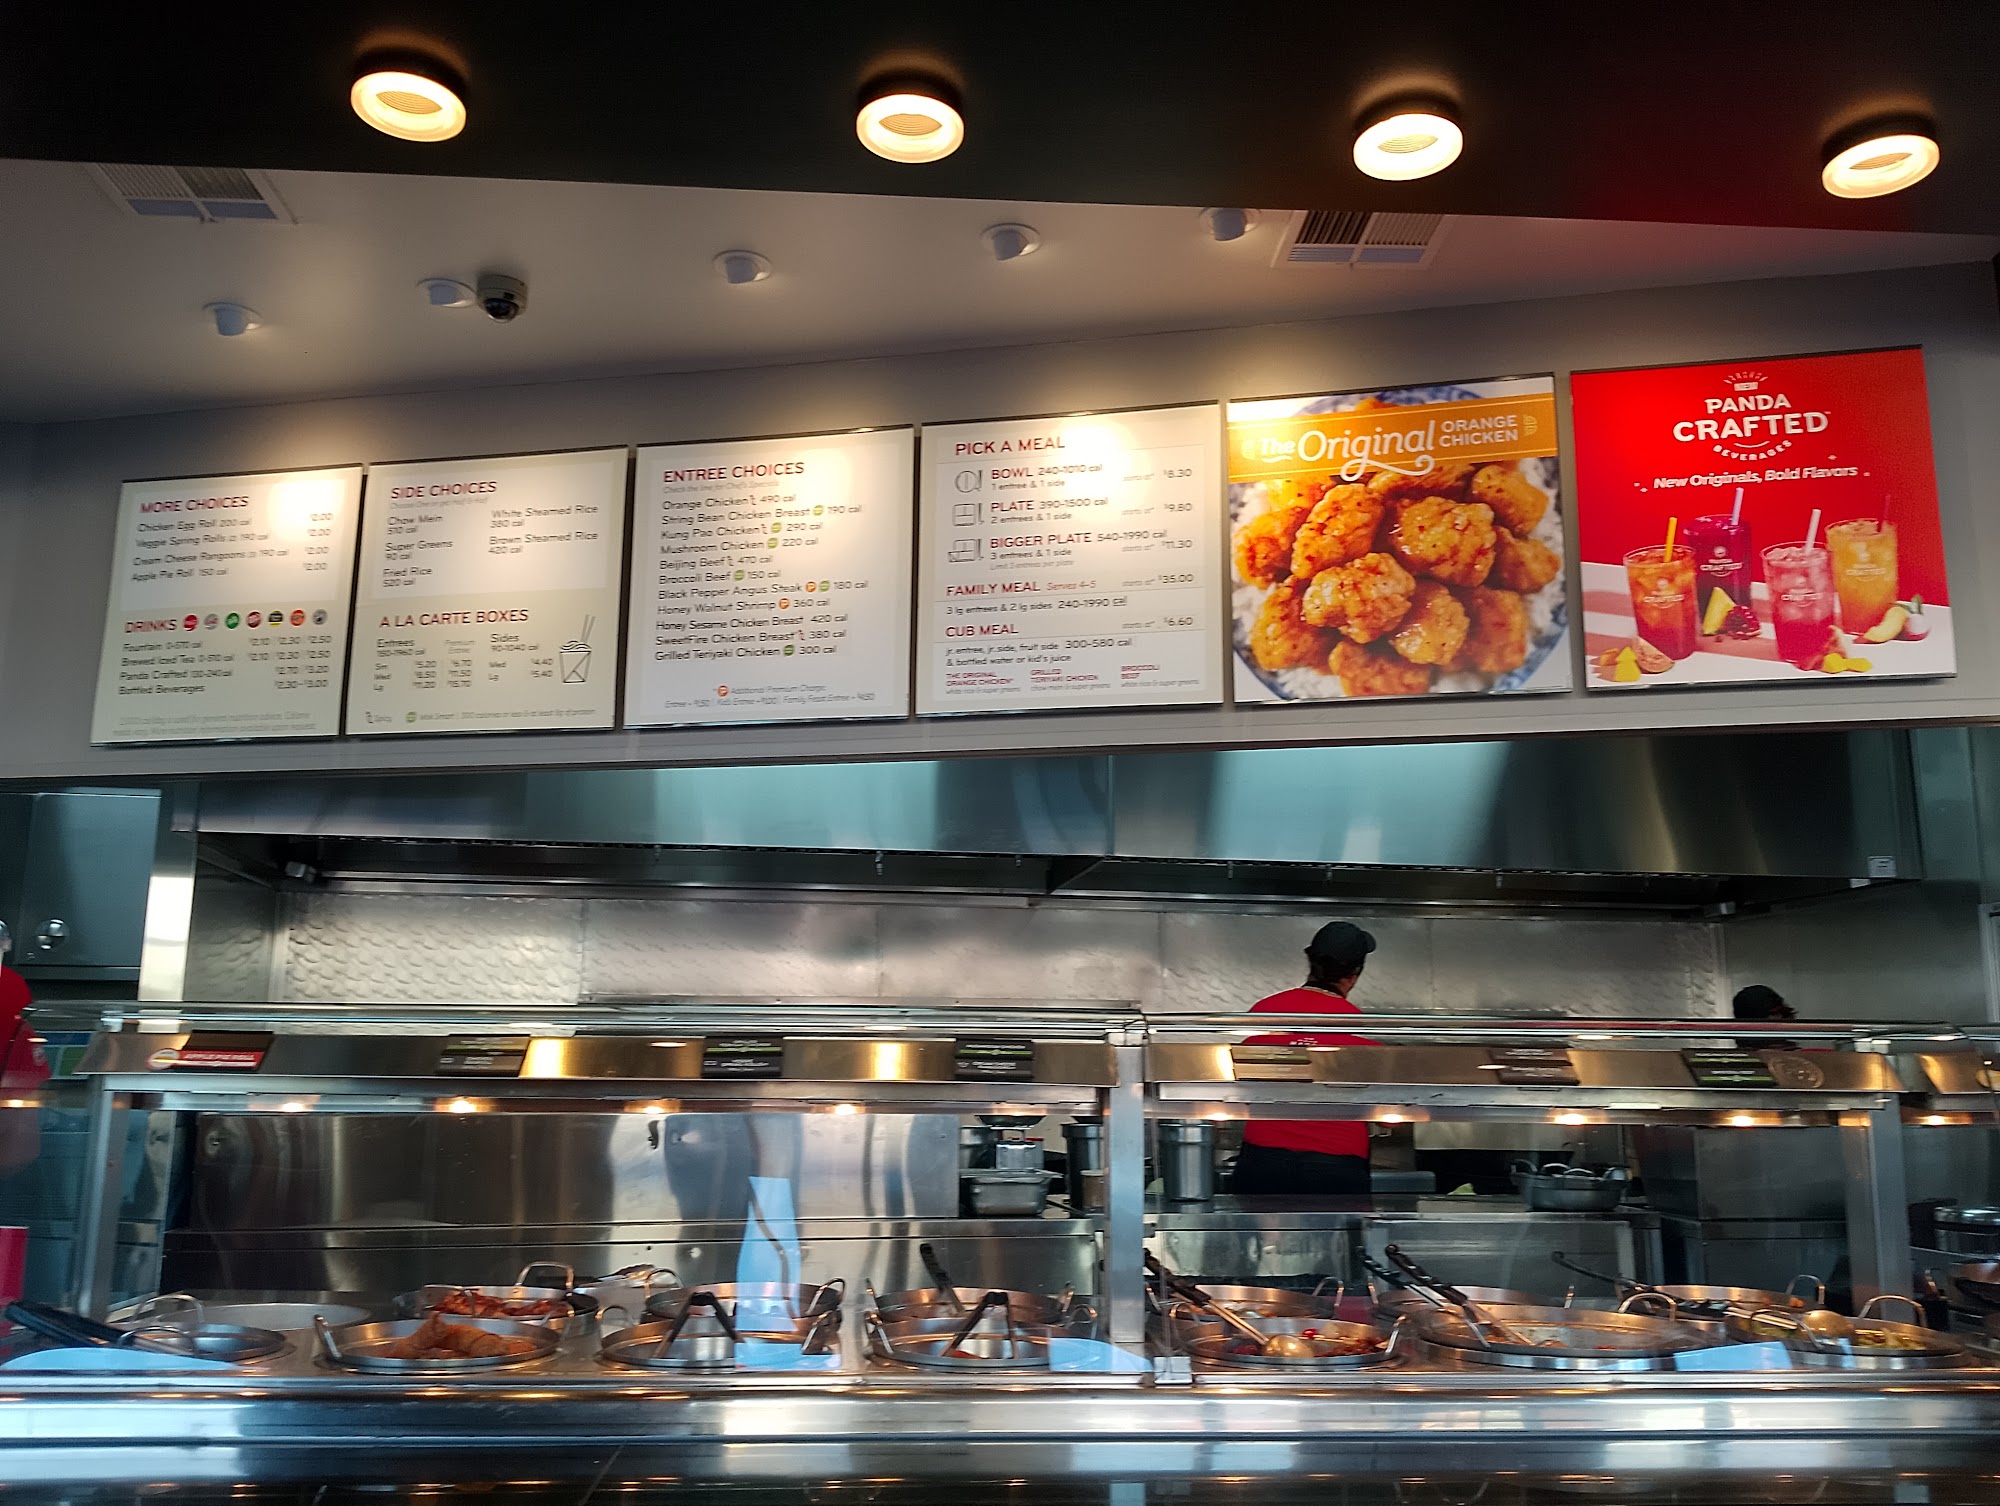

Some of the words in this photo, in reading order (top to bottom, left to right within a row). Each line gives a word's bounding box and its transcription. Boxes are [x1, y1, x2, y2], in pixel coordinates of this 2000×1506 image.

[1704, 393, 1792, 414] PANDA
[1441, 414, 1517, 433] ORANGE
[1672, 411, 1829, 442] CRAFTED
[955, 441, 995, 455] PICK
[1000, 440, 1013, 452] A
[1018, 437, 1066, 452] MEAL
[1439, 428, 1519, 448] CHICKEN
[1260, 437, 1295, 453] The
[1298, 420, 1435, 482] Original
[1713, 440, 1792, 461] BEVERAGES
[664, 467, 727, 482] ENTREE
[732, 462, 805, 478] CHOICES
[991, 467, 1034, 479] BOWL
[1088, 463, 1103, 472] cal
[1653, 477, 1688, 489] New
[1689, 470, 1763, 487] Originals,
[1764, 467, 1801, 482] Bold
[1802, 466, 1859, 480] Flavors
[391, 486, 425, 499] SIDE
[429, 481, 497, 496] CHOICES
[998, 482, 1027, 491] entree
[1047, 479, 1065, 487] side
[140, 500, 183, 513] MORE
[186, 495, 249, 511] CHOICES
[525, 504, 571, 516] Steamed
[575, 504, 598, 514] Rice
[662, 500, 702, 511] Orange
[705, 497, 748, 507] Chicken
[760, 494, 780, 503] 490
[782, 493, 797, 502] cal
[991, 500, 1035, 512] PLATE
[1038, 498, 1091, 510] 390-1500
[1094, 497, 1109, 506] cal
[387, 516, 414, 526] Chow
[418, 514, 443, 523] Mein
[661, 515, 694, 526] String
[697, 513, 725, 522] Bean
[728, 510, 771, 520] Chicken
[775, 508, 810, 518] Breast
[848, 504, 862, 513] cal
[1000, 516, 1034, 524] entrees
[1053, 512, 1072, 520] side
[525, 532, 571, 543] Steamed
[575, 531, 598, 540] Rice
[661, 530, 689, 541] Kung
[692, 528, 713, 537] Pao
[716, 526, 759, 536] Chicken
[786, 523, 807, 532] 290
[809, 522, 823, 530] cal
[990, 535, 1043, 549] BIGGER
[1047, 532, 1092, 545] PLATE
[1097, 530, 1150, 542] 540-1990
[1152, 529, 1168, 538] cal
[385, 542, 415, 553] Super
[417, 540, 454, 550] Greens
[660, 544, 718, 554] Mushroom
[721, 541, 764, 551] Chicken
[782, 538, 803, 547] 220
[805, 537, 819, 546] cal
[999, 551, 1034, 560] entrees
[1052, 548, 1072, 557] side
[660, 560, 696, 571] Beijing
[700, 556, 725, 567] Beef
[759, 555, 773, 563] cal
[659, 573, 702, 585] Broccoli
[705, 571, 732, 582] Beef
[767, 569, 781, 578] cal
[658, 589, 687, 600] Black
[690, 588, 730, 599] Pepper
[732, 586, 768, 597] Angus
[770, 583, 802, 593] Steak
[854, 580, 869, 589] cal
[946, 583, 998, 596] FAMILY
[1001, 581, 1041, 593] MEAL
[1046, 582, 1077, 591] Serves
[657, 605, 691, 615] Honey
[694, 603, 733, 612] Walnut
[736, 601, 776, 611] Shrimp
[793, 599, 814, 608] 360
[816, 598, 830, 606] cal
[955, 606, 963, 616] lg
[965, 606, 998, 614] entrees
[1020, 602, 1027, 612] lg
[1030, 602, 1053, 610] sides
[1058, 598, 1110, 609] 240-1990
[1112, 595, 1128, 605] cal
[125, 619, 178, 633] DRINKS
[379, 616, 390, 627] A
[394, 614, 415, 627] LA
[419, 611, 471, 626] CARTE
[476, 609, 529, 623] BOXES
[656, 620, 686, 631] Honey
[688, 620, 727, 630] Sesame
[729, 618, 769, 628] Chicken
[771, 616, 804, 626] Breast
[810, 614, 832, 623] 420
[834, 613, 848, 622] cal
[490, 633, 520, 643] Sides
[655, 634, 708, 646] SweetFire
[711, 633, 756, 643] Chicken
[832, 629, 846, 638] cal
[945, 625, 975, 637] CUB
[979, 624, 1019, 635] MEAL
[655, 650, 690, 661] Grilled
[692, 649, 733, 660] Teriyaki
[735, 647, 780, 657] Chicken
[799, 645, 821, 655] 300
[822, 645, 837, 654] cal
[1020, 643, 1038, 651] fruit
[1041, 642, 1059, 650] side
[1064, 638, 1115, 649] 300-580
[1117, 638, 1132, 647] cal
[955, 657, 987, 666] bottled
[989, 657, 1014, 665] water
[1016, 656, 1026, 664] or
[1027, 654, 1048, 663] kid's
[1049, 654, 1072, 664] juice
